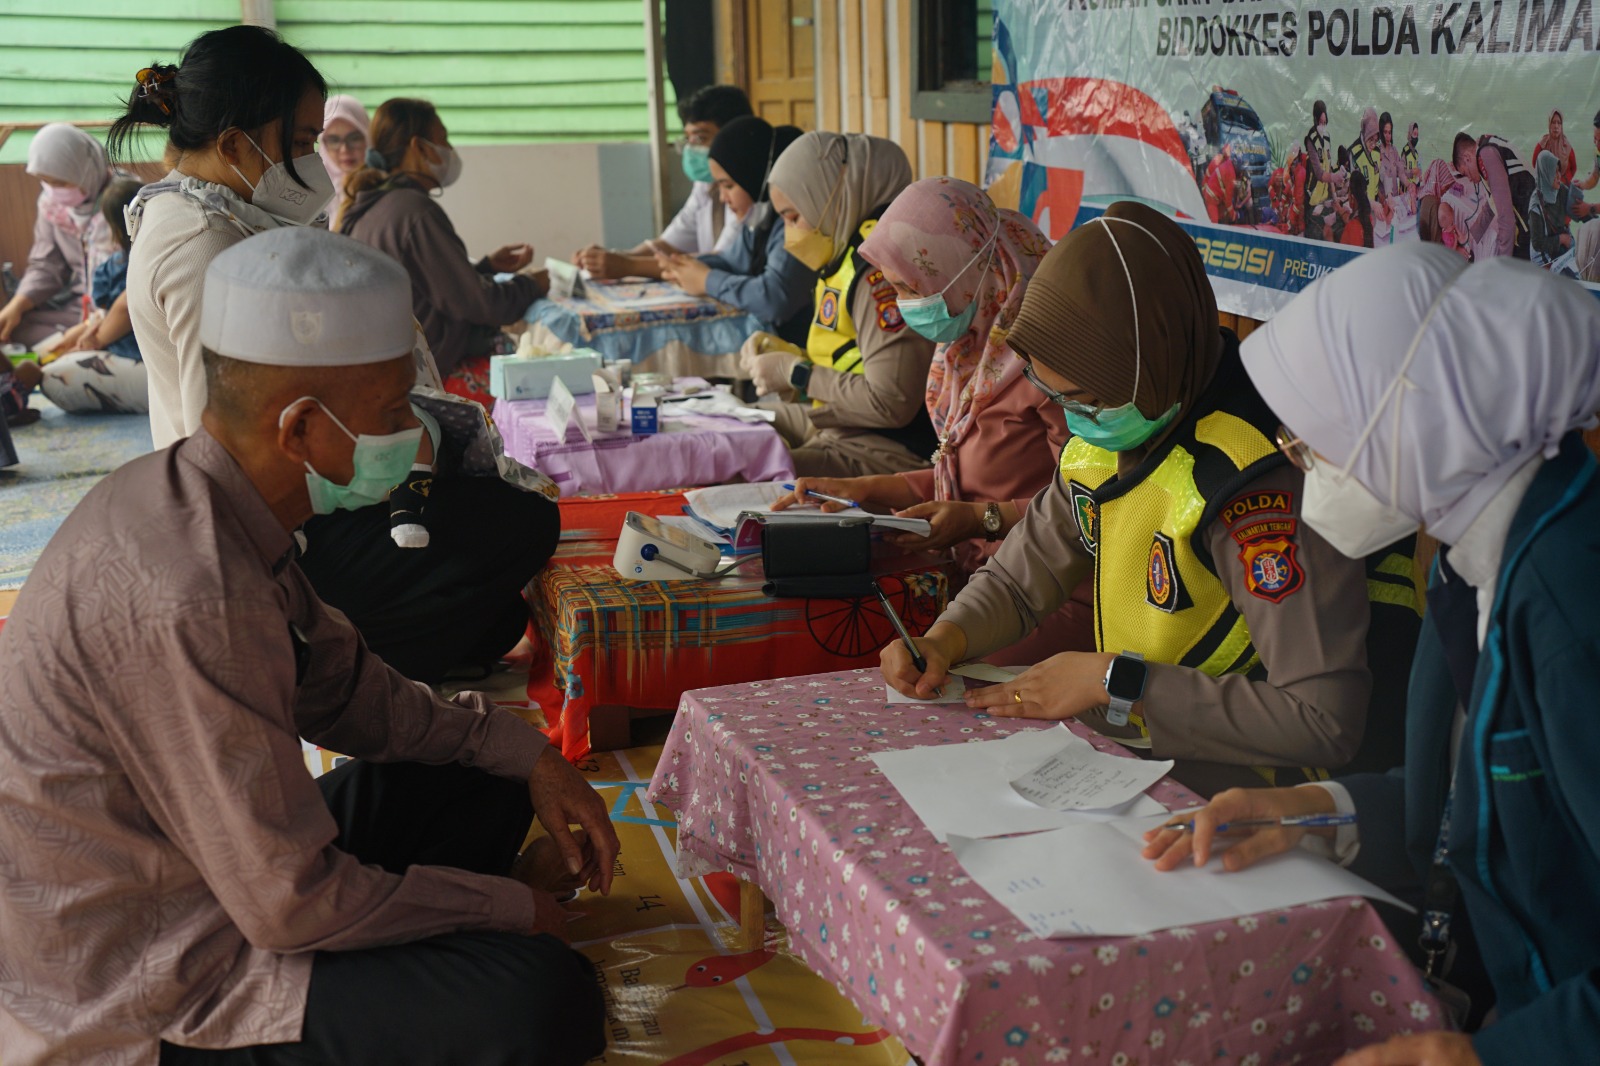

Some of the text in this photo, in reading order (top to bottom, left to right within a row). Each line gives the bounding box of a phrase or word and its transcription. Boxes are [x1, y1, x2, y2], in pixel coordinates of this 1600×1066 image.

[1156, 0, 1600, 57] BIDDOKKES POLDA KALIMA
[1190, 235, 1275, 276] RESISI
[1223, 494, 1287, 523] POLDA
[1236, 521, 1292, 541] KALIMANTAN TENGAH
[635, 894, 667, 912] 14
